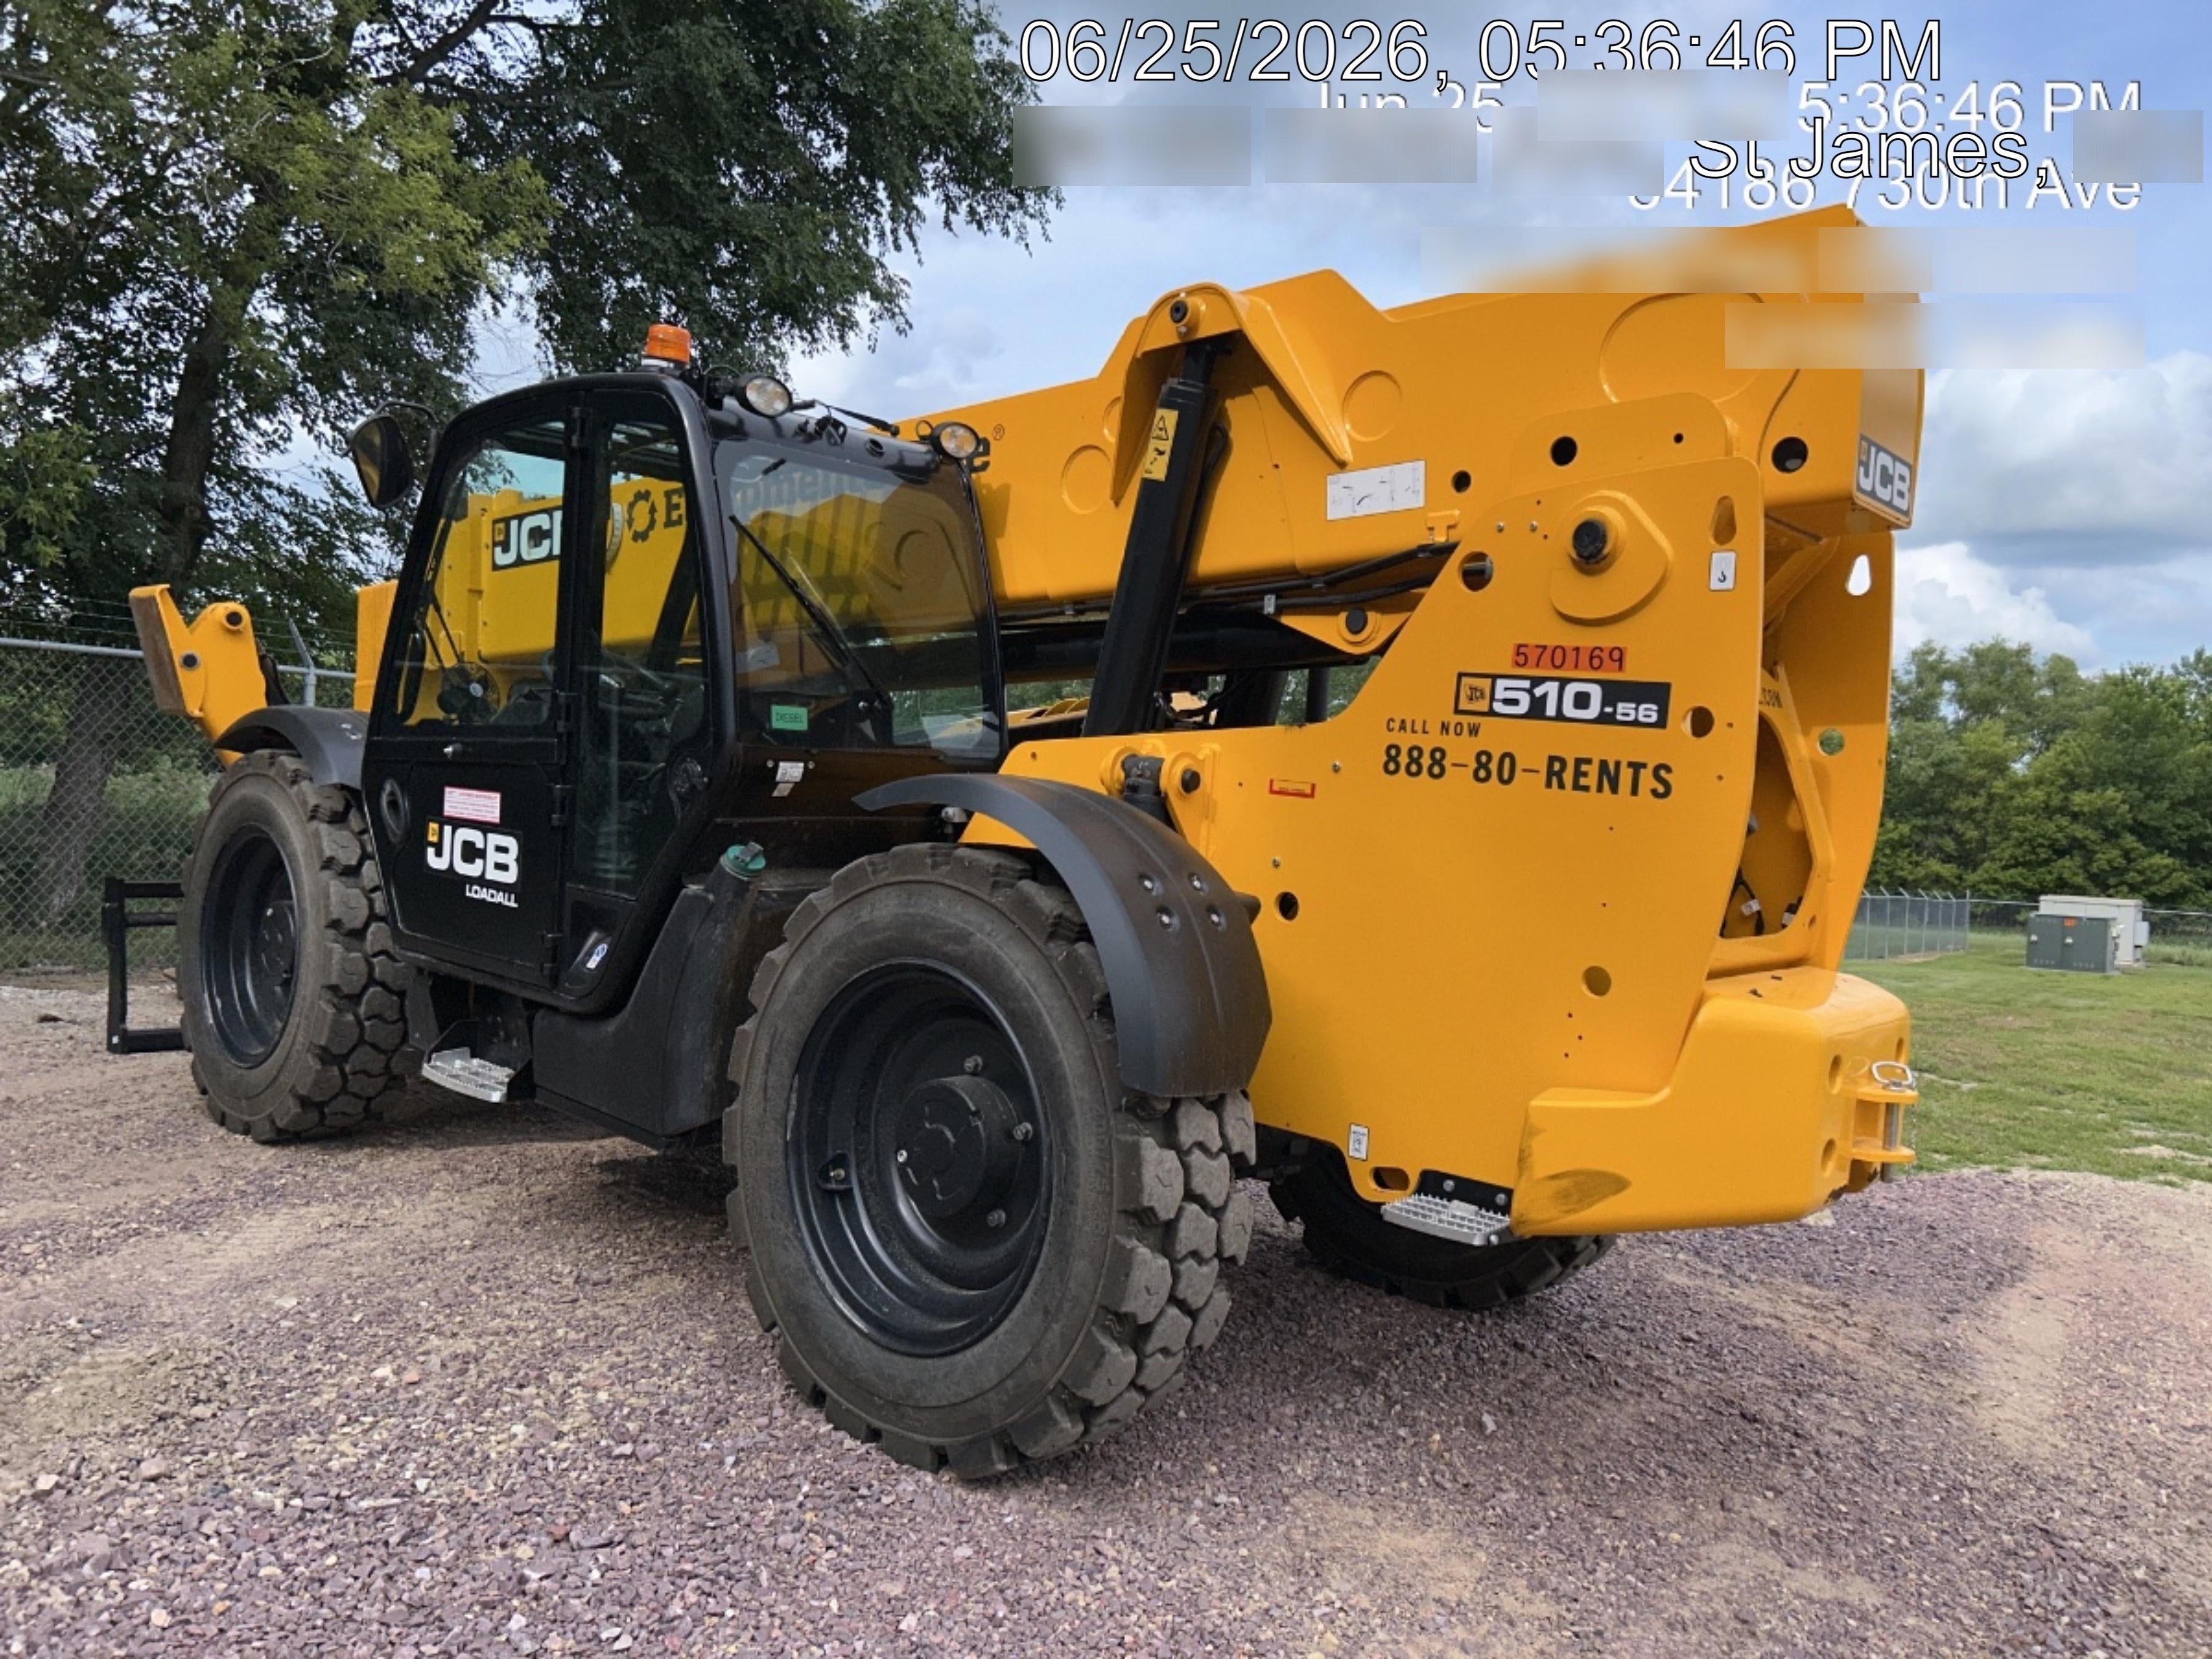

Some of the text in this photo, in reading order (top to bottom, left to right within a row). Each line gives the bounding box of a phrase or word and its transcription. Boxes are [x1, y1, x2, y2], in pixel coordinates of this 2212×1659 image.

[1859, 445, 1911, 511] JCB
[1514, 643, 1623, 672] 570169
[1492, 678, 1658, 723] 510-56
[1386, 717, 1481, 737] CALL NOW
[1383, 743, 1674, 799] 888-80-RENTS
[427, 825, 519, 884] JCB
[466, 884, 519, 908] LOADALL
